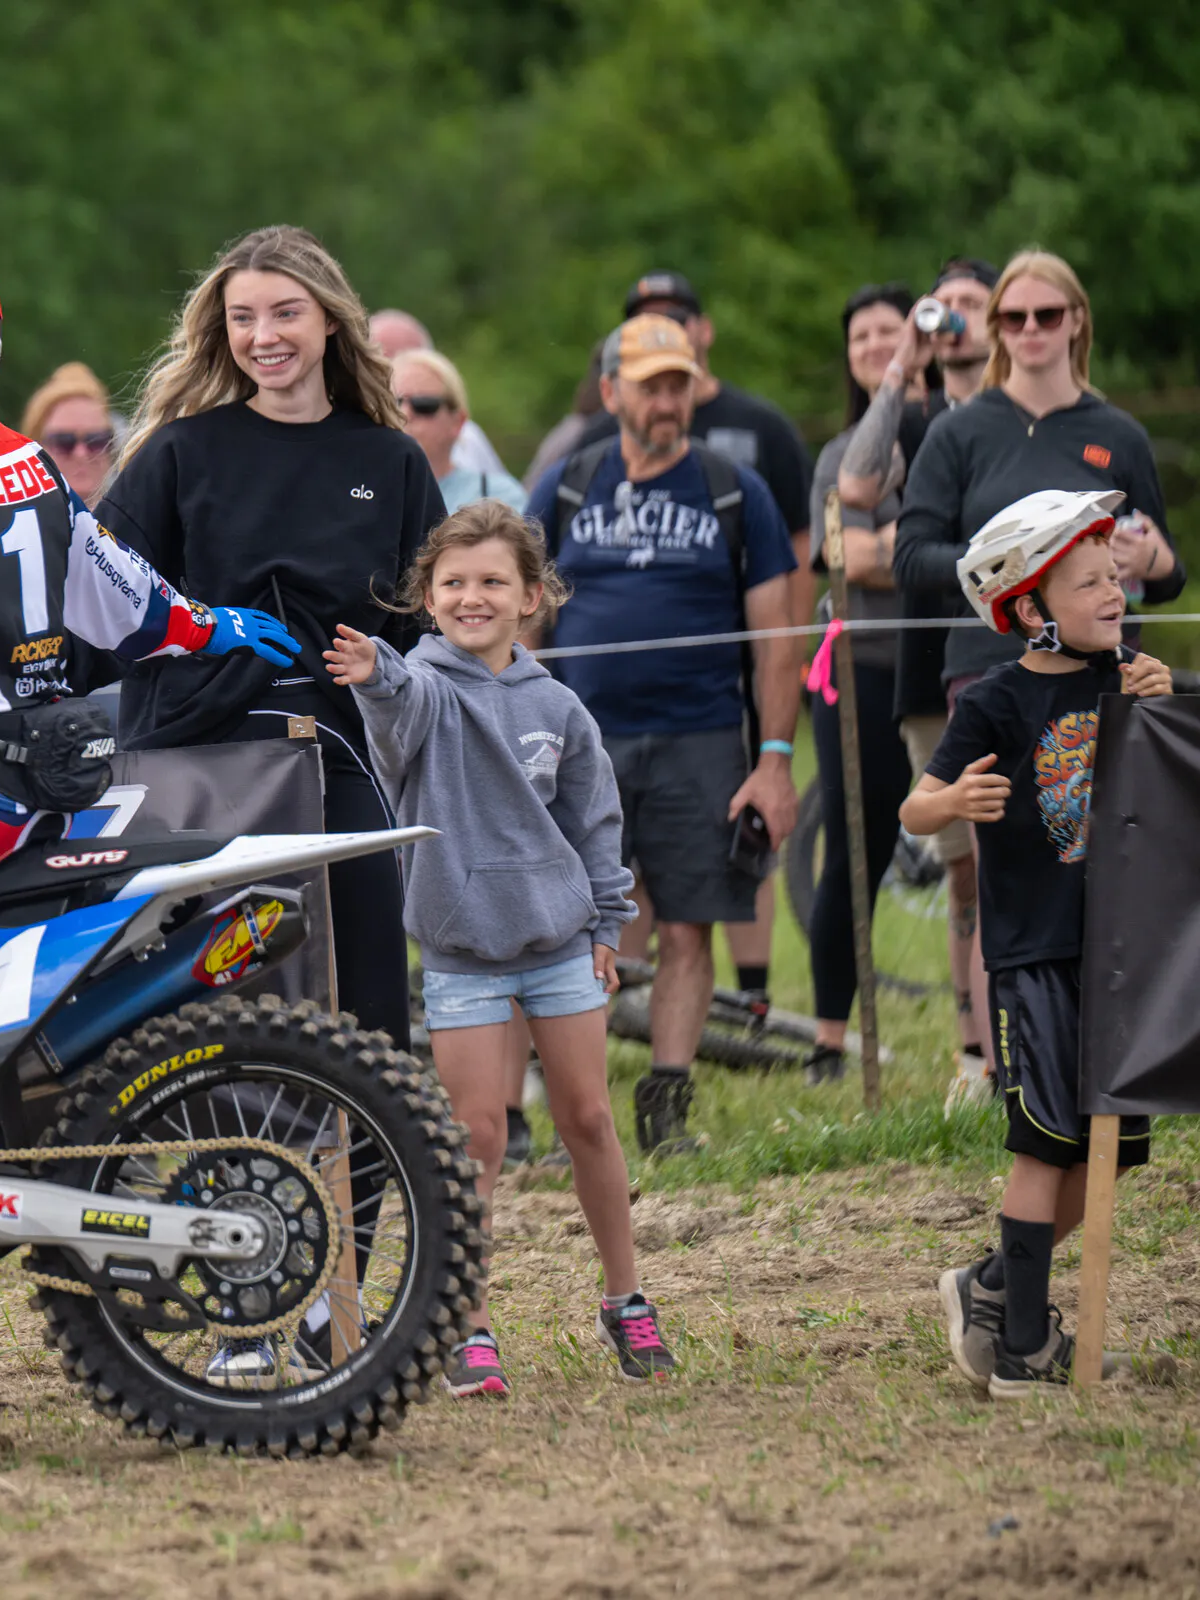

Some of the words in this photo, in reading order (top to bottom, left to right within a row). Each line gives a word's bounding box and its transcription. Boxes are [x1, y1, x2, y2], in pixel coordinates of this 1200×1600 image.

[350, 484, 374, 500] alo
[571, 500, 720, 549] GLACIER
[1, 507, 49, 636] 1
[93, 546, 142, 610] Husqvarna
[45, 850, 128, 868] GUTS
[117, 1043, 224, 1108] DUNLOP
[84, 1209, 149, 1229] EXCEL
